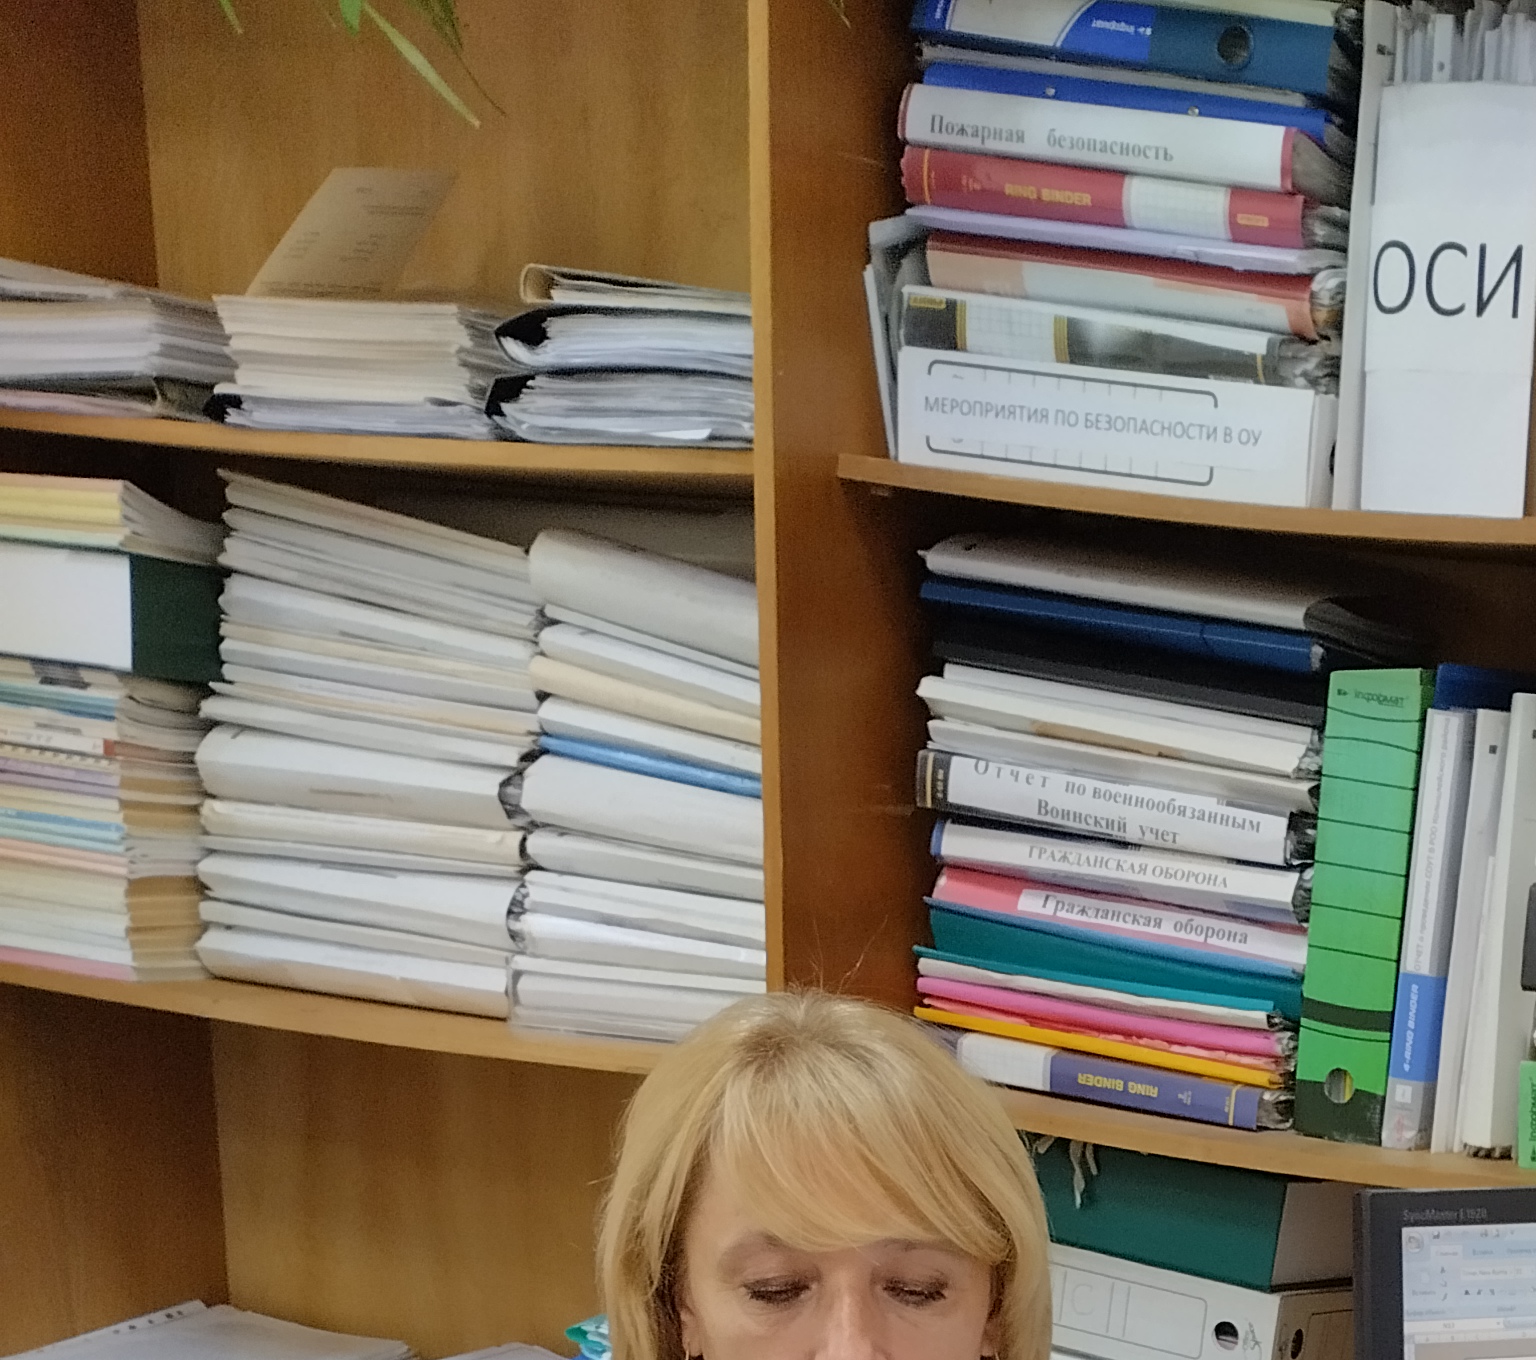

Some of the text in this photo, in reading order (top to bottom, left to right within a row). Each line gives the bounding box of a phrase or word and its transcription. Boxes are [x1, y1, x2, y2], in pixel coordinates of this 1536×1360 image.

[929, 113, 1174, 163] Пожарная безопасность
[1004, 182, 1092, 207] RING BINDER
[1372, 240, 1525, 319] ОСИ
[924, 395, 1262, 448] МЕРОПРИЯТИЯ ПО БЕЗОПАСНОСТИ В ОУ
[1036, 798, 1180, 847] Воинский учет
[1064, 775, 1087, 798] по
[1091, 784, 1262, 834] военнообязанным
[1026, 844, 1230, 890] ГРАЖДАНСКАЯ ОБОРОНА
[1041, 893, 1249, 946] Гражданская оборона
[1077, 1072, 1158, 1099] RING BINDER
